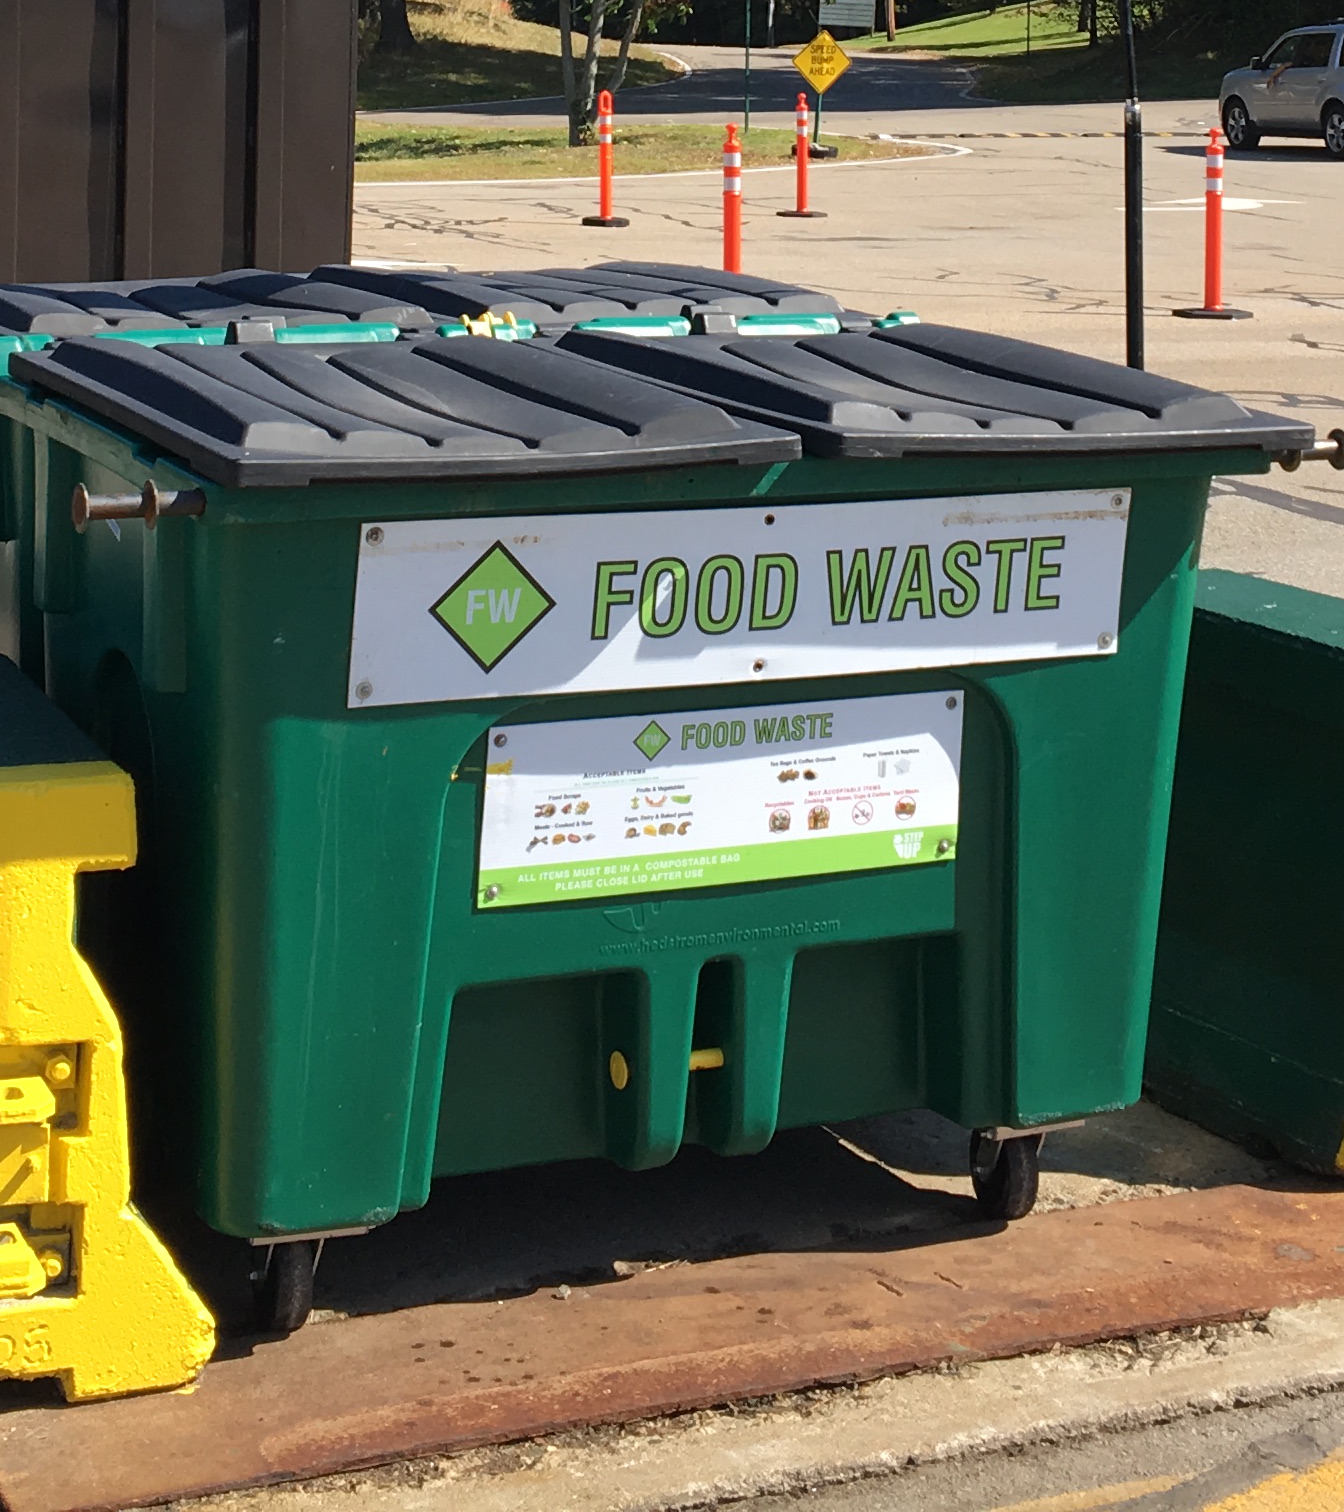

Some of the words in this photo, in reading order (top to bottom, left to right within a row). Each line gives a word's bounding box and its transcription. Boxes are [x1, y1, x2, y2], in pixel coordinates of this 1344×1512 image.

[810, 44, 836, 54] SPEED
[811, 56, 834, 64] BUMP
[809, 66, 836, 75] AHEAD
[590, 552, 799, 640] FOOD
[826, 535, 1066, 625] WASTE
[465, 587, 522, 625] FW
[644, 733, 661, 746] FW
[681, 720, 746, 750] FOOD
[754, 713, 833, 744] WASTE
[904, 831, 924, 843] STEP
[903, 842, 921, 859] UP
[517, 873, 536, 883] ALL
[539, 870, 570, 881] ITEMS
[573, 866, 601, 877] MUST
[604, 865, 617, 875] BE
[620, 864, 631, 873] IN
[633, 863, 640, 872] A
[645, 855, 717, 871] COMPOSTABLE
[720, 853, 741, 863] BAG
[554, 880, 593, 891] PLEASE
[596, 876, 629, 887] CLOSE
[631, 874, 648, 884] LID
[650, 871, 682, 881] AFTER
[684, 868, 704, 879] USE
